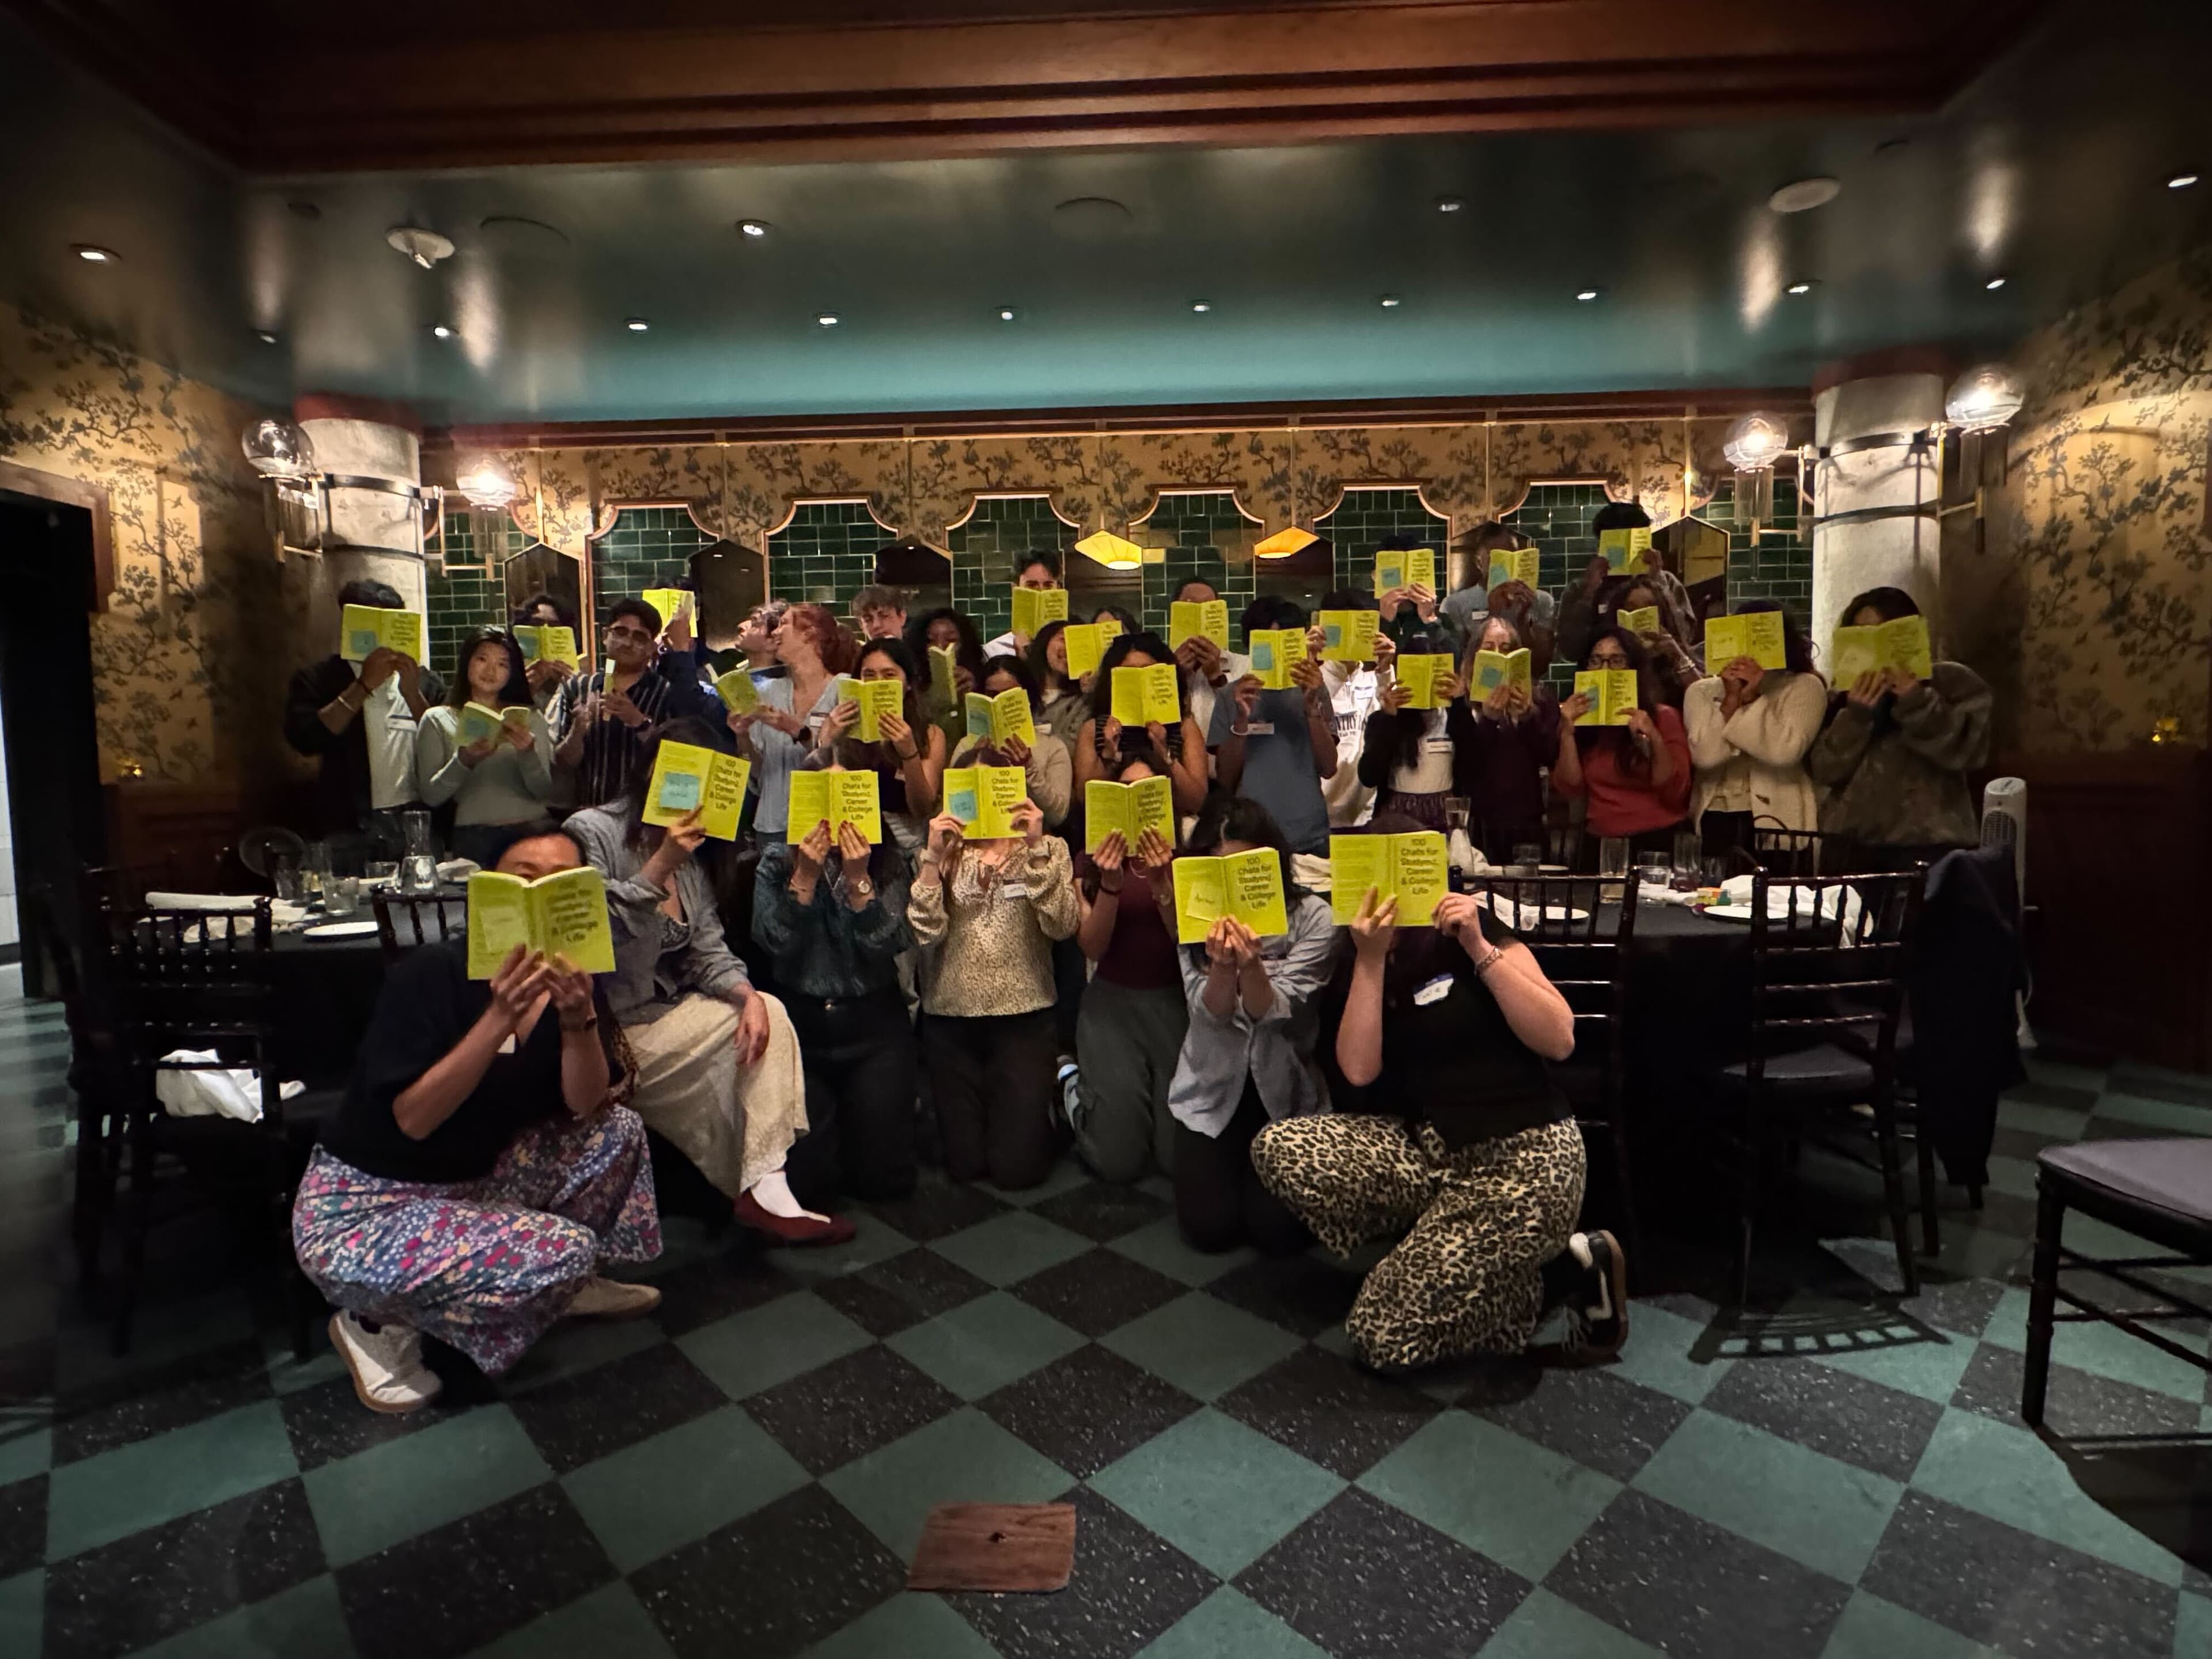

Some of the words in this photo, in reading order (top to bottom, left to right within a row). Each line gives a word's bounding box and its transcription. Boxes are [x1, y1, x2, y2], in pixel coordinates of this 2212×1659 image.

[848, 805, 873, 813] College
[1401, 847, 1425, 856] Chats
[1426, 847, 1438, 855] for
[1247, 856, 1260, 865] 100
[1238, 866, 1260, 876] Chats
[1261, 865, 1271, 873] for
[1245, 884, 1269, 892] Career
[1248, 892, 1275, 900] College
[1252, 900, 1267, 909] Life
